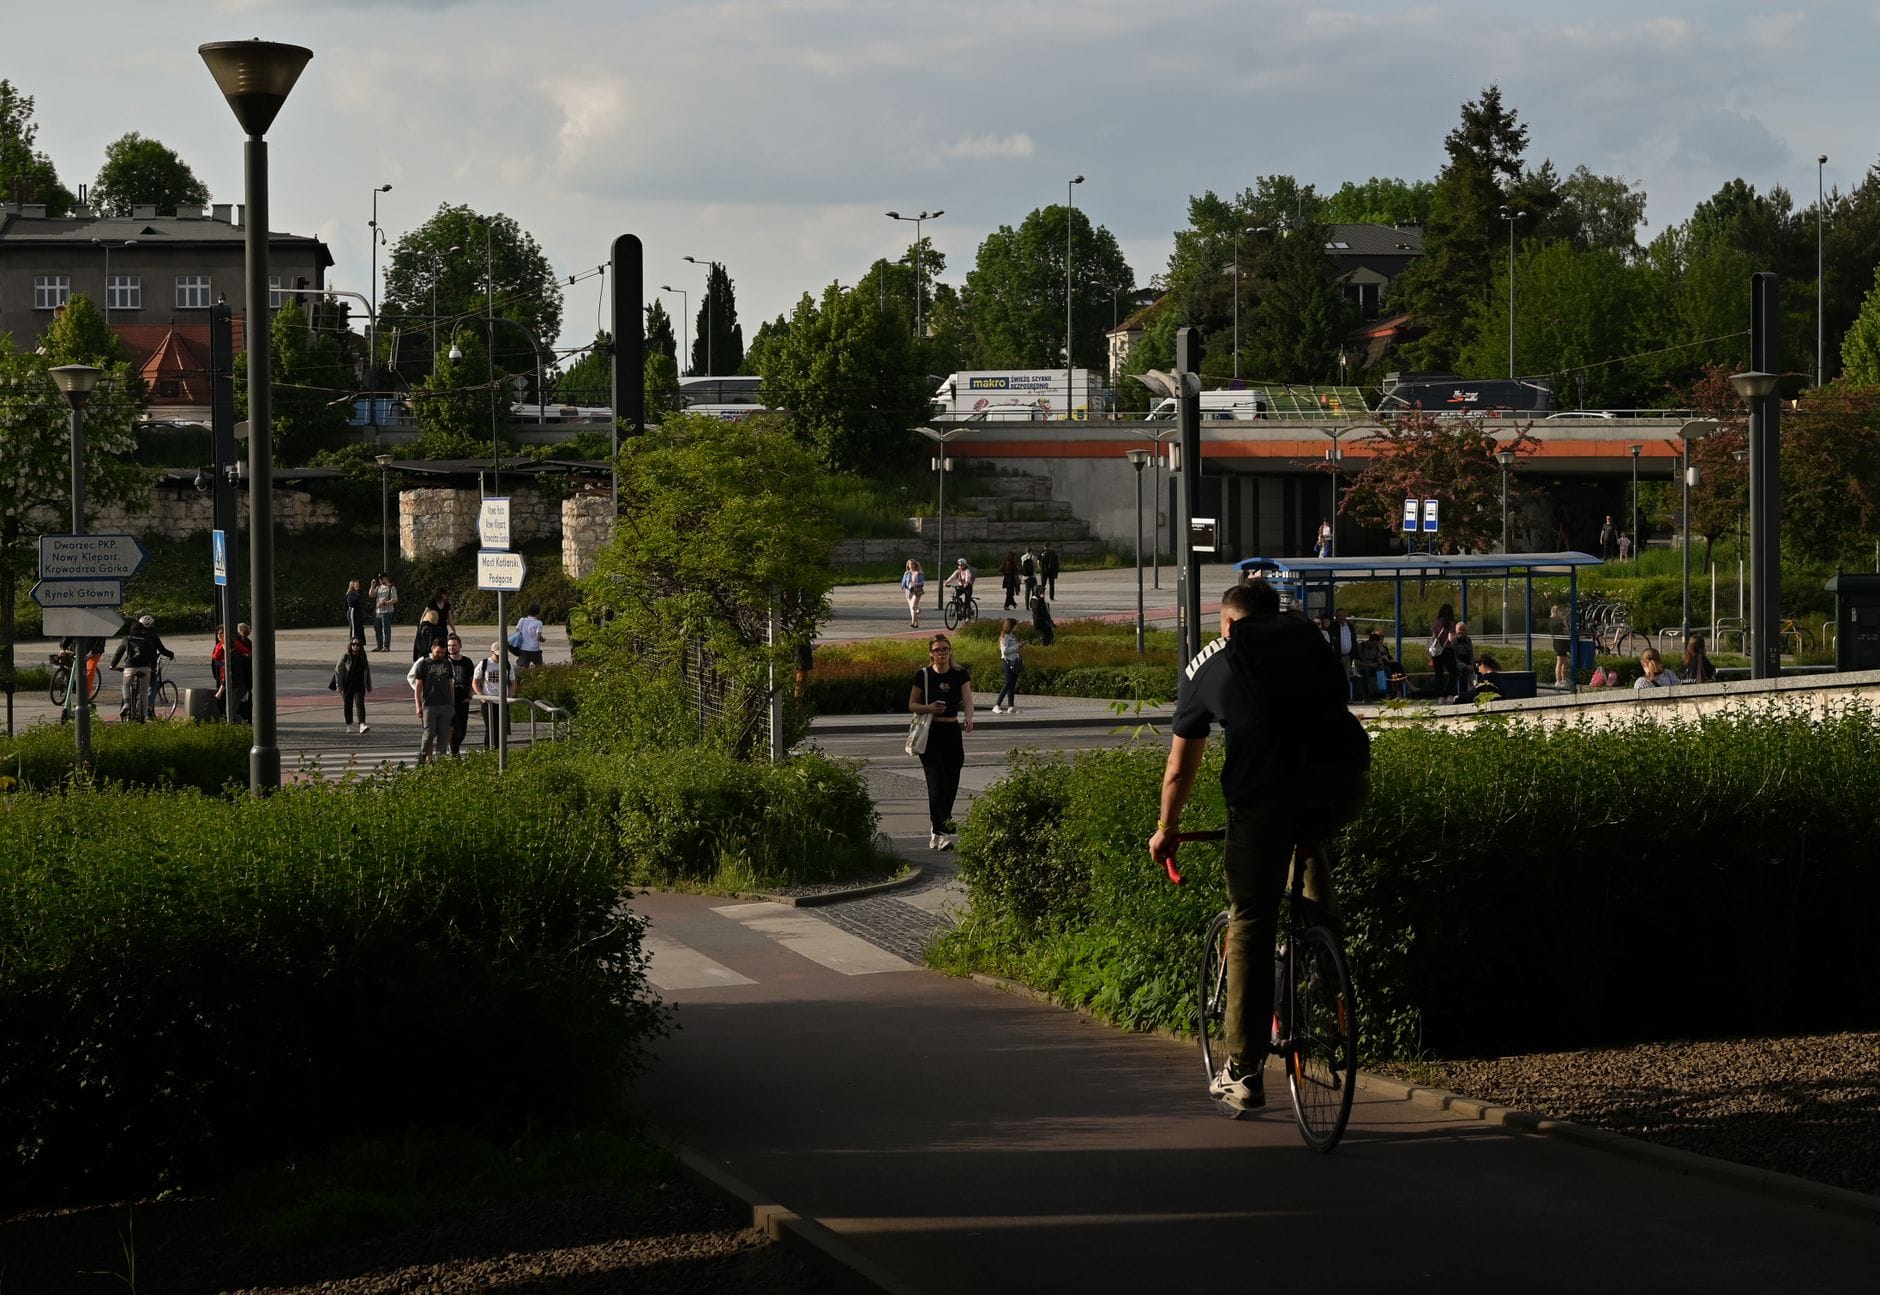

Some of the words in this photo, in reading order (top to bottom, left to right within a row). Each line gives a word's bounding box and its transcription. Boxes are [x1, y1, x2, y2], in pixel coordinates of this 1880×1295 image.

[973, 379, 1006, 388] makro
[54, 541, 94, 550] Dworzec
[52, 553, 79, 563] Nowy
[482, 557, 495, 567] Most
[45, 564, 96, 574] Krowodrza
[45, 590, 75, 599] Rynek
